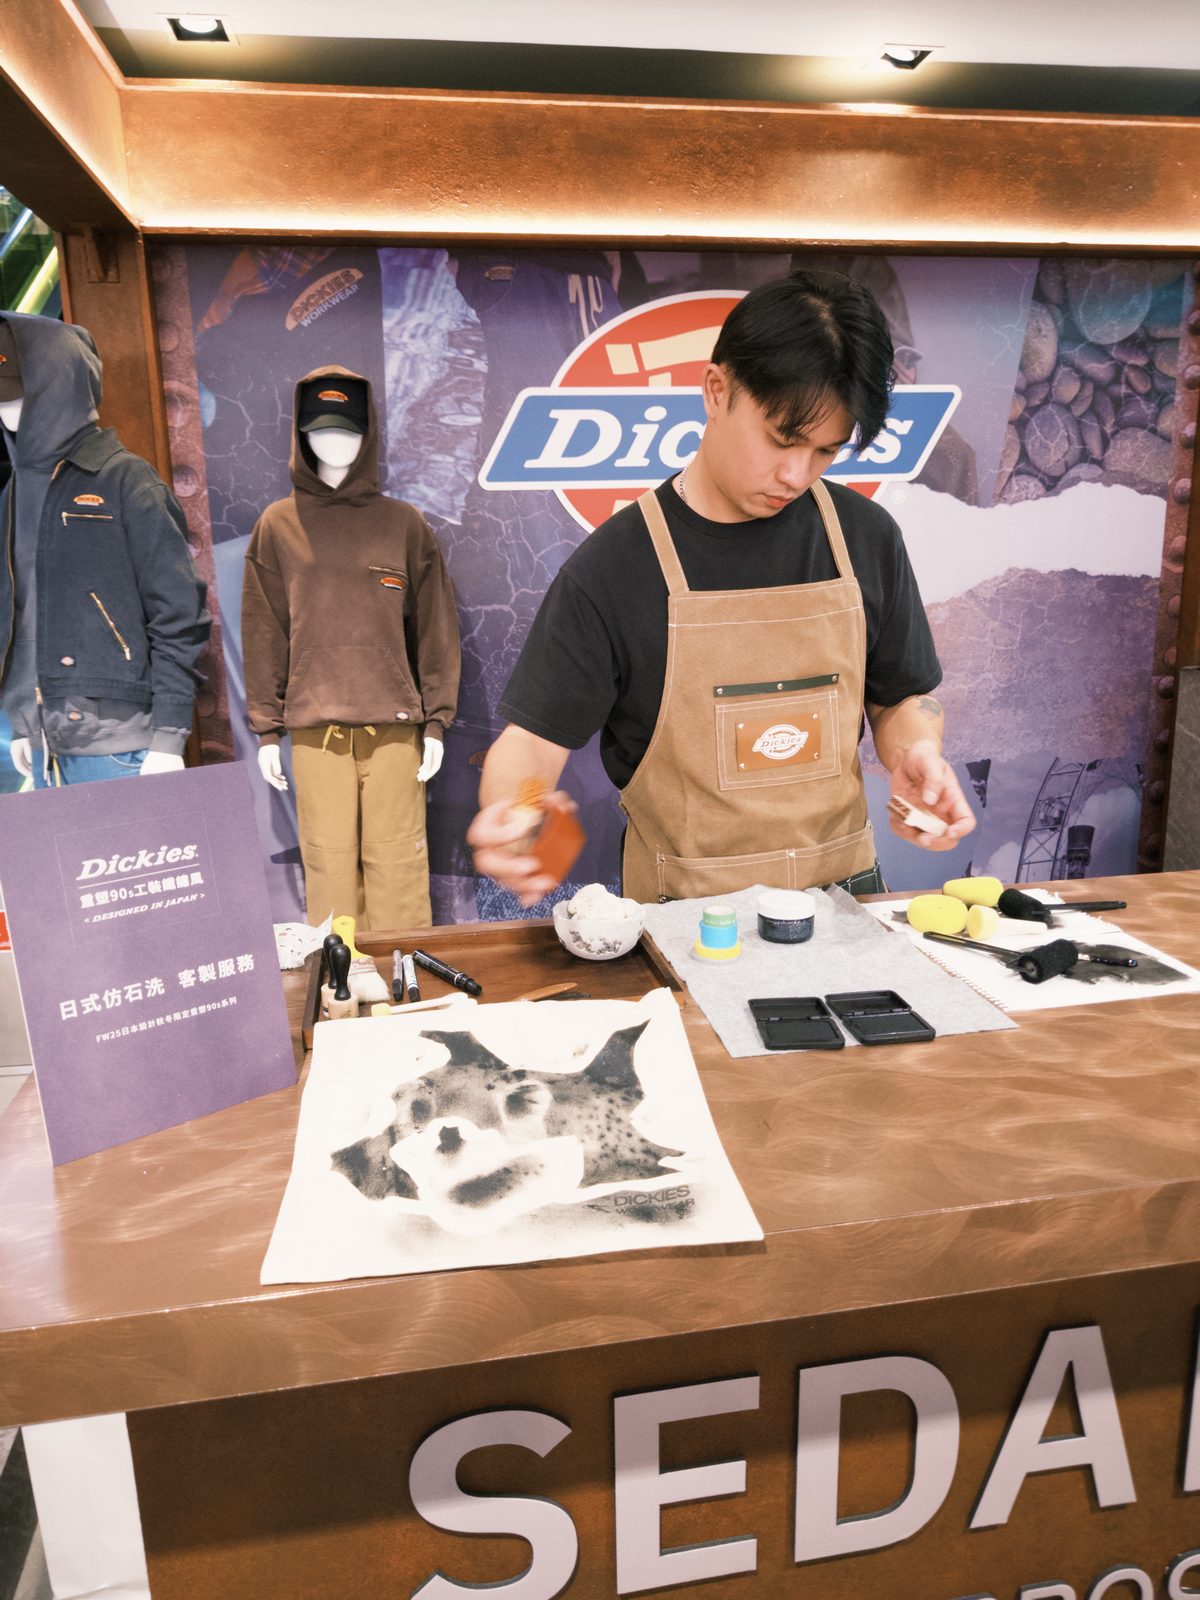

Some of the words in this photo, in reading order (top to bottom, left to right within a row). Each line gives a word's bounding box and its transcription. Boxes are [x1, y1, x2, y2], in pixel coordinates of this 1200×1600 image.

[291, 270, 356, 321] DICKIES
[301, 284, 359, 327] WORKWEAR
[523, 406, 914, 468] Dics
[762, 737, 801, 747] Dickies
[92, 905, 148, 922] DESIGNED
[150, 901, 164, 910] IN
[163, 893, 198, 908] JAPAN
[60, 977, 165, 1021] 日式仿石洗
[178, 953, 254, 988] 客製服務
[614, 1185, 690, 1206] DICKIES
[409, 1303, 1200, 1600] SEDA
